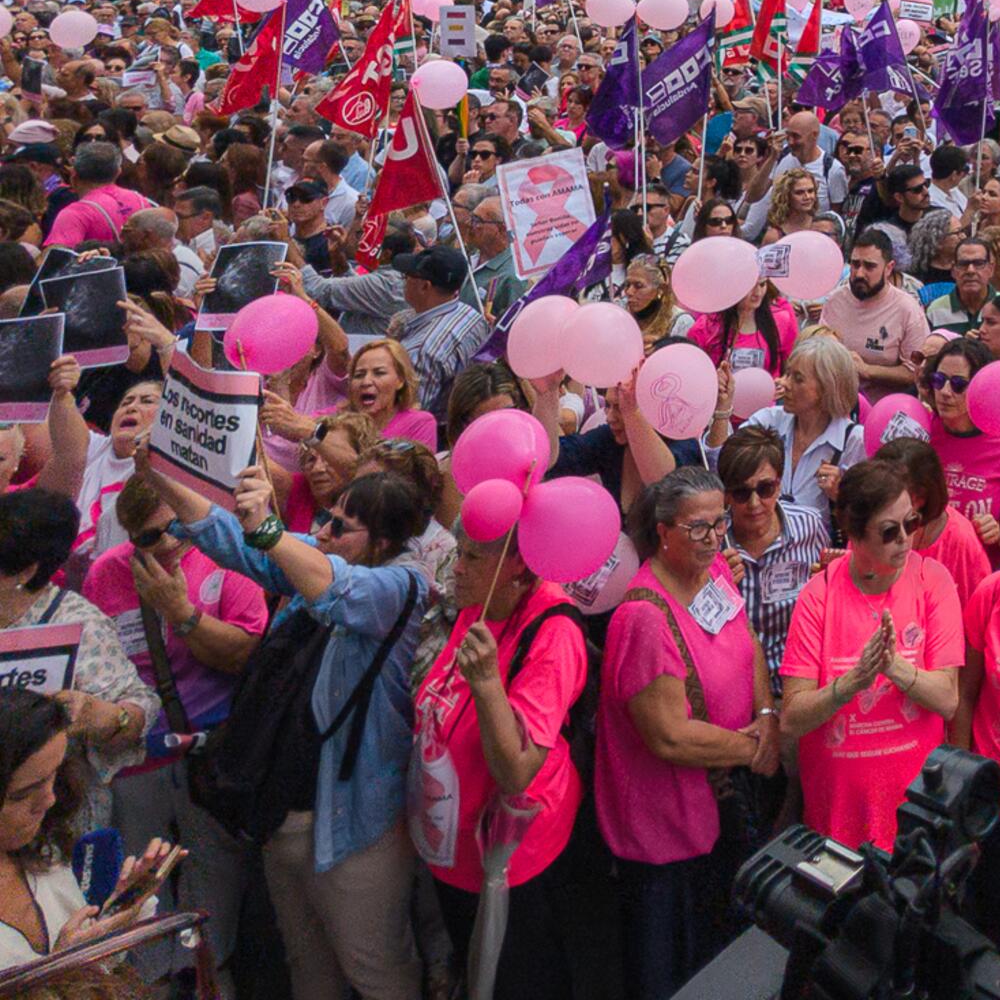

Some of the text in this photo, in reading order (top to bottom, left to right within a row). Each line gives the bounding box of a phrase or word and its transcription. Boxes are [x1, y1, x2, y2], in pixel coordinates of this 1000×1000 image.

[161, 378, 241, 432] Los recortes
[160, 409, 227, 456] en sanidad
[170, 439, 208, 471] matan
